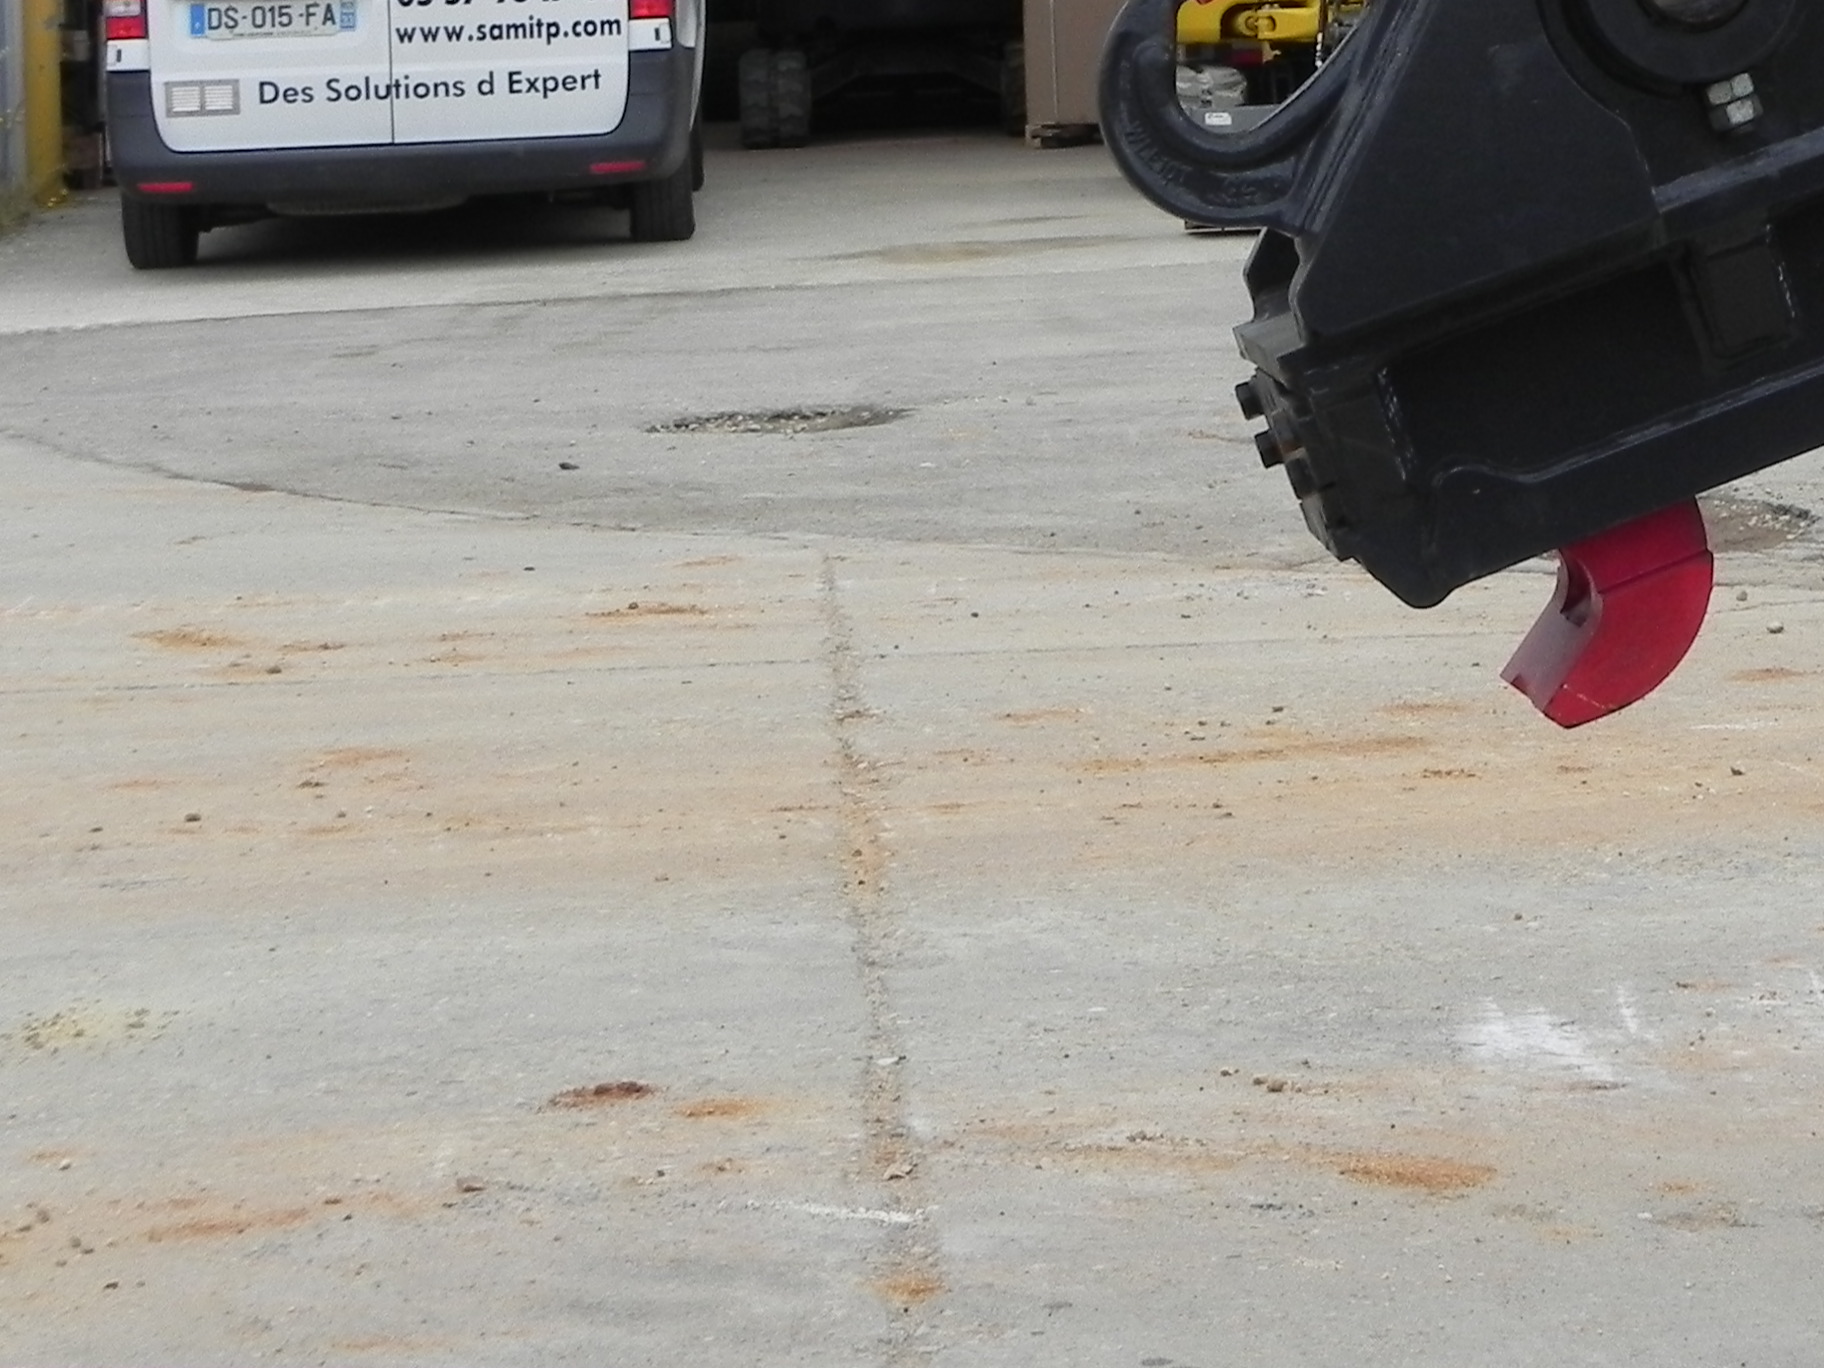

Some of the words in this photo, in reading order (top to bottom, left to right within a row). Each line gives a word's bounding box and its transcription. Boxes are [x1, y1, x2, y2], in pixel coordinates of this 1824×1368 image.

[396, 14, 622, 45] www.samitp.com
[259, 80, 314, 105] Des
[326, 75, 466, 102] Solutions
[477, 70, 495, 96] d
[508, 69, 602, 99] Expert
